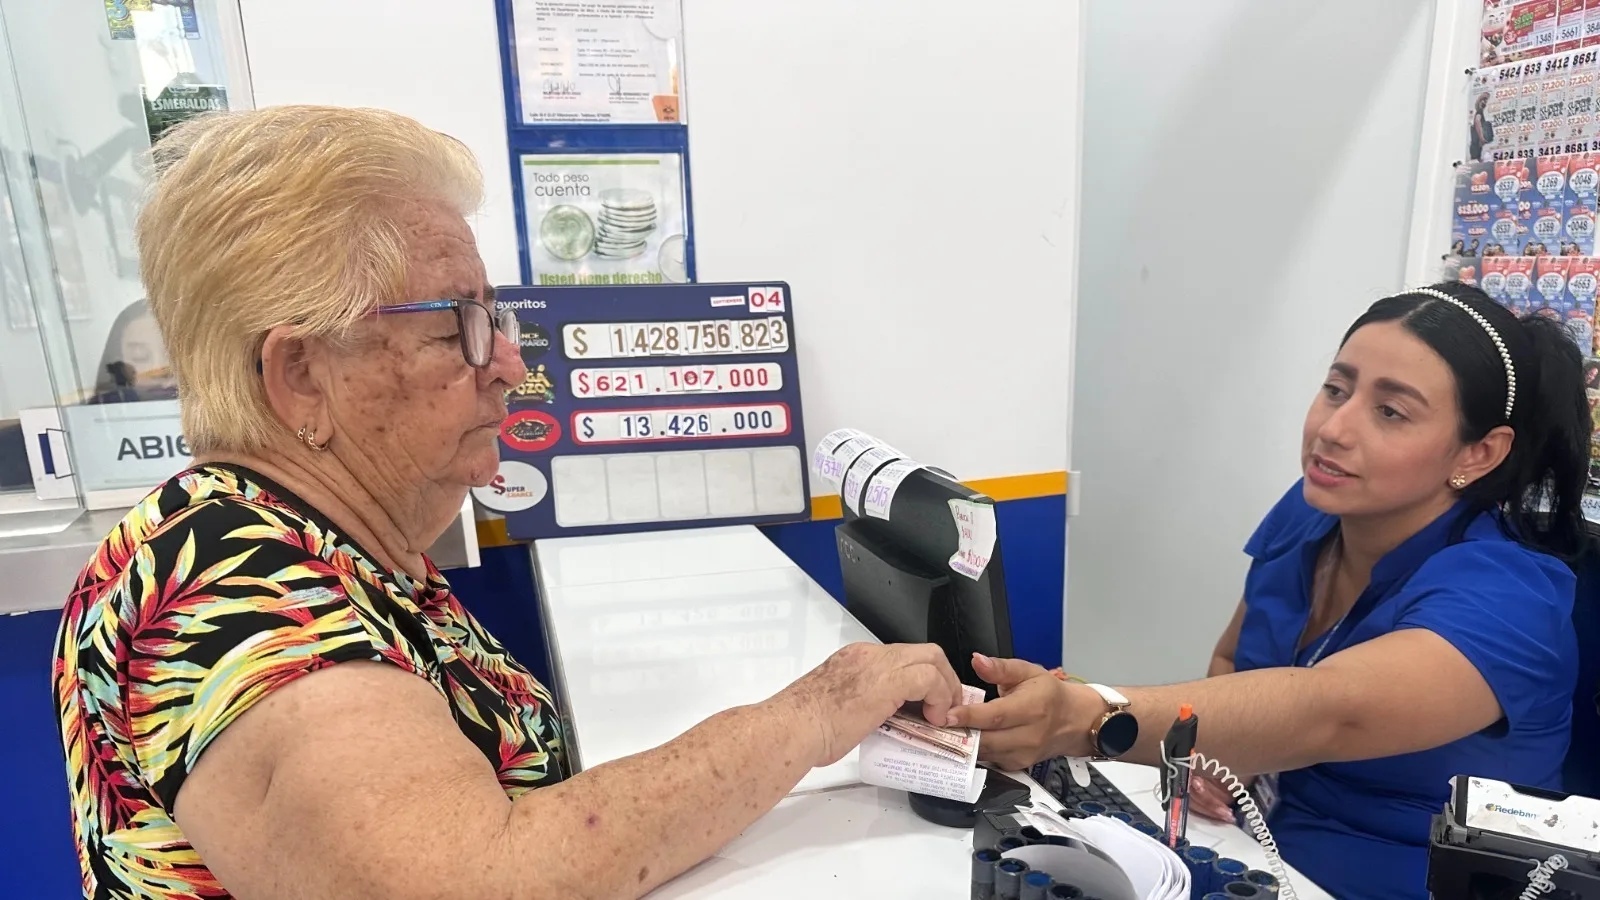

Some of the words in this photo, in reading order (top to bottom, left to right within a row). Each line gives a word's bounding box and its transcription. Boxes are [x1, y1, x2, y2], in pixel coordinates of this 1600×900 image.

[1562, 26, 1578, 39] 5661
[1499, 66, 1521, 80] 5424
[1524, 62, 1542, 75] 933
[1545, 56, 1569, 72] 3412
[1572, 50, 1597, 65] 8681
[151, 98, 221, 110] ESMERALDAS
[1493, 150, 1514, 161] 5424
[1517, 149, 1534, 158] 933
[1538, 146, 1561, 156] 3412
[1564, 142, 1588, 153] 8681
[534, 172, 560, 183] Todo
[563, 173, 589, 185] peso
[534, 184, 590, 197] cuenta
[540, 273, 576, 285] Usted
[578, 272, 610, 285] tiene
[612, 272, 662, 285] derecho
[751, 291, 781, 308] 04
[573, 326, 588, 356] $
[614, 320, 784, 354] 1.428.756.823
[583, 417, 594, 439] $
[1495, 805, 1537, 820] Redeban
